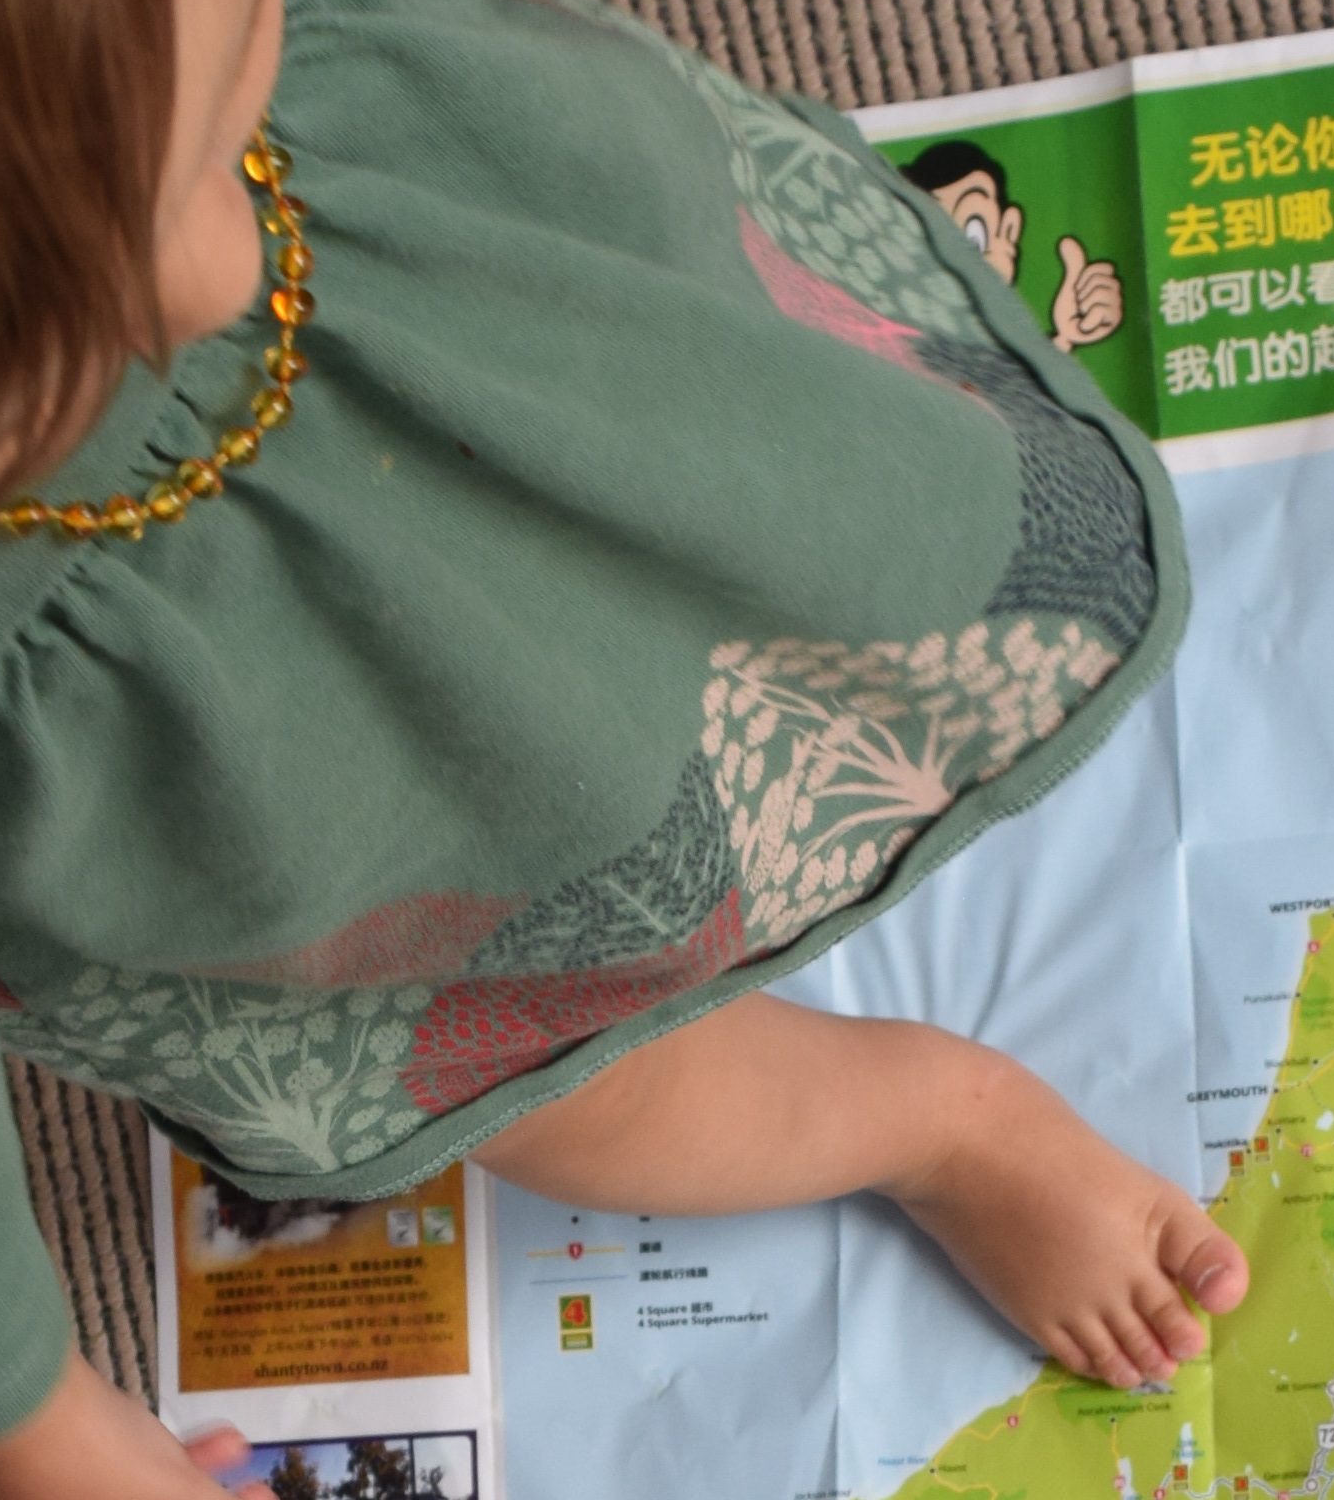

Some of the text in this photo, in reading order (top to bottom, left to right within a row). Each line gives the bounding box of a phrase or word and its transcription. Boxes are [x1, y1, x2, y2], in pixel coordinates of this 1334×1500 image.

[1186, 1085, 1268, 1103] GREYMOUTH
[562, 1299, 588, 1325] 4
[647, 1303, 688, 1317] Square
[647, 1315, 688, 1329] Square
[690, 1310, 769, 1328] Supermarket
[253, 1355, 389, 1381] shantytown.co.nz
